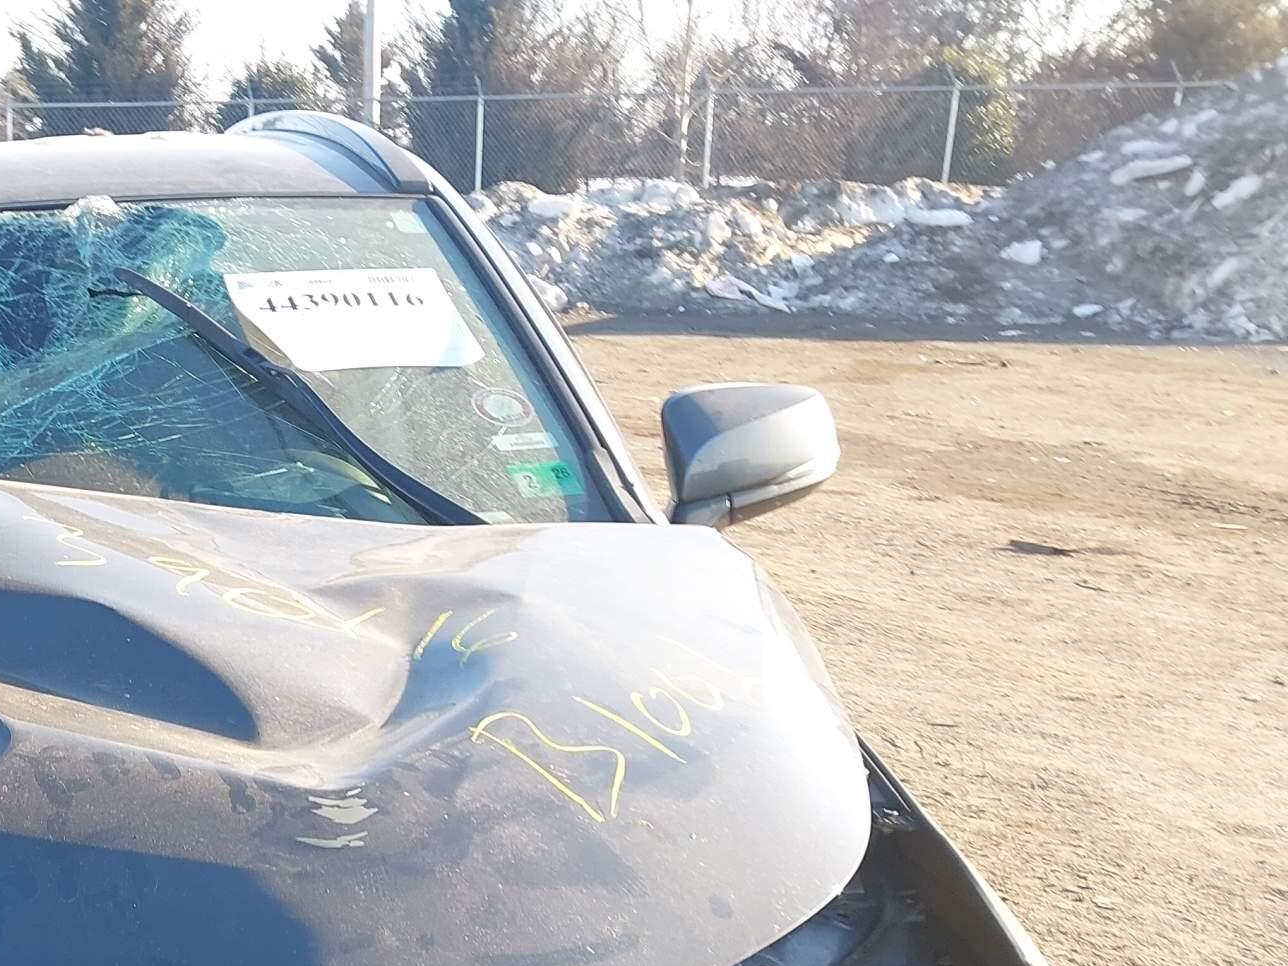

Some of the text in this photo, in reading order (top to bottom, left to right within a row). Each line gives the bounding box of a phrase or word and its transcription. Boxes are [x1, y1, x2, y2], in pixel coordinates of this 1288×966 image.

[259, 291, 424, 313] 44390116
[522, 463, 571, 490] 2 26
